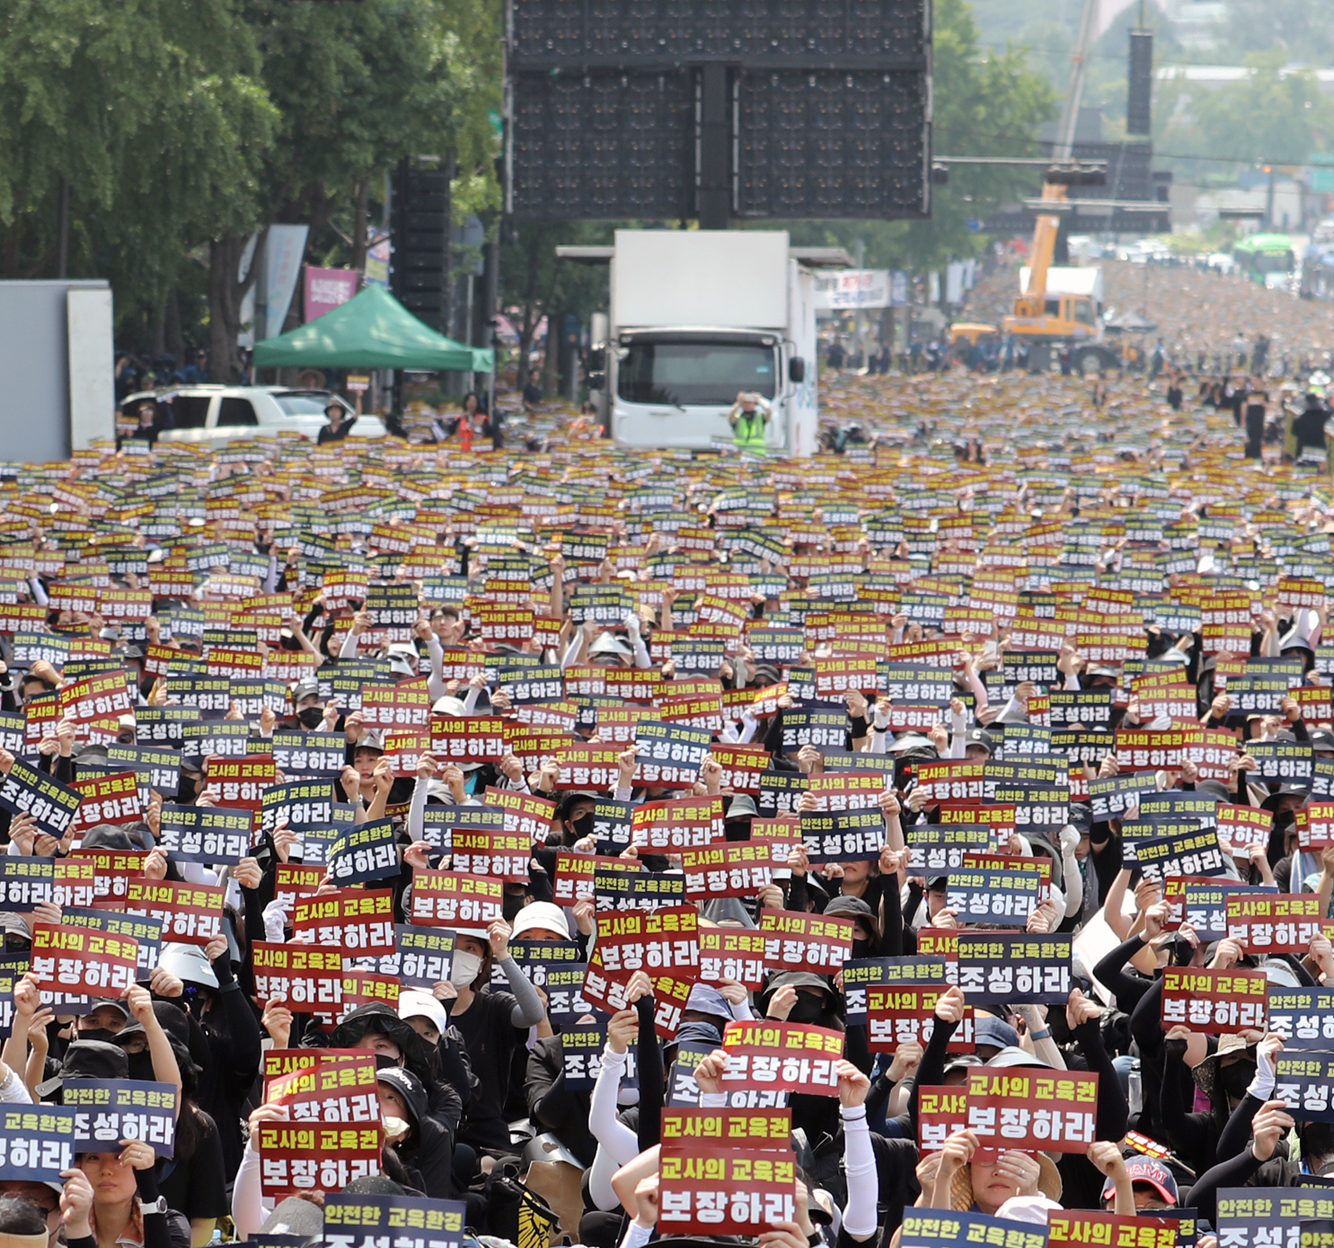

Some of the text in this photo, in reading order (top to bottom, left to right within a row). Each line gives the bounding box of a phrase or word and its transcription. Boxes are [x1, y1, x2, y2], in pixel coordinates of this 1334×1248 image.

[683, 846, 769, 866] 교사의 교육권
[686, 869, 771, 894] 보장하라
[35, 931, 137, 960] 교사의 교육권
[957, 943, 1070, 958] 안전한 교육환경
[31, 957, 136, 995] 보장하라
[959, 966, 1070, 995] 조성하라
[1277, 1060, 1321, 1076] 안전한
[325, 1205, 462, 1231] 안전한 교육환경
[899, 1218, 960, 1239] 안전한
